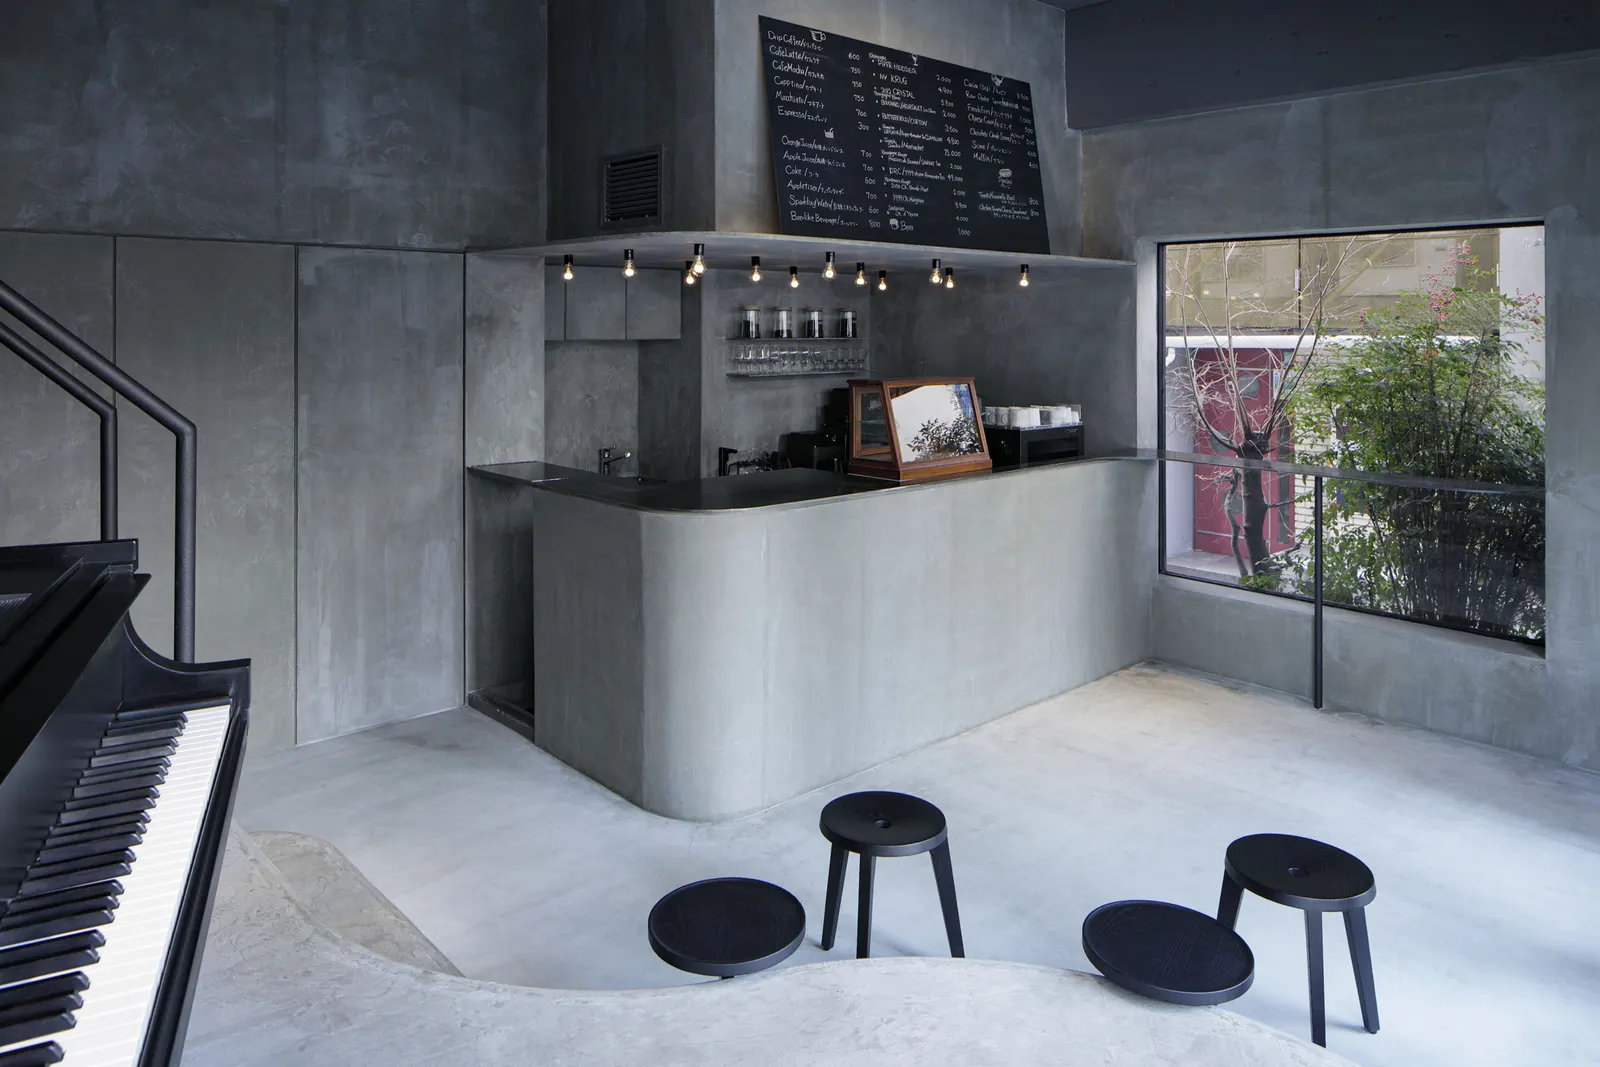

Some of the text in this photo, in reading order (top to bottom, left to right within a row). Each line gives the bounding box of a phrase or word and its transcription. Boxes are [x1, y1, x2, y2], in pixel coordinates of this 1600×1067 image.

[848, 52, 860, 60] 600
[850, 66, 861, 74] 750
[852, 80, 863, 88] 750
[891, 74, 908, 85] KRUG
[853, 94, 865, 102] 750
[856, 108, 867, 117] 700
[857, 121, 869, 131] 300
[860, 149, 872, 158] 700
[785, 164, 801, 175] Coke
[862, 163, 873, 172] 700
[864, 176, 876, 185] 600
[865, 191, 877, 199] 700
[868, 205, 879, 214] 600
[868, 219, 881, 228] 800
[900, 220, 914, 231] Beer
